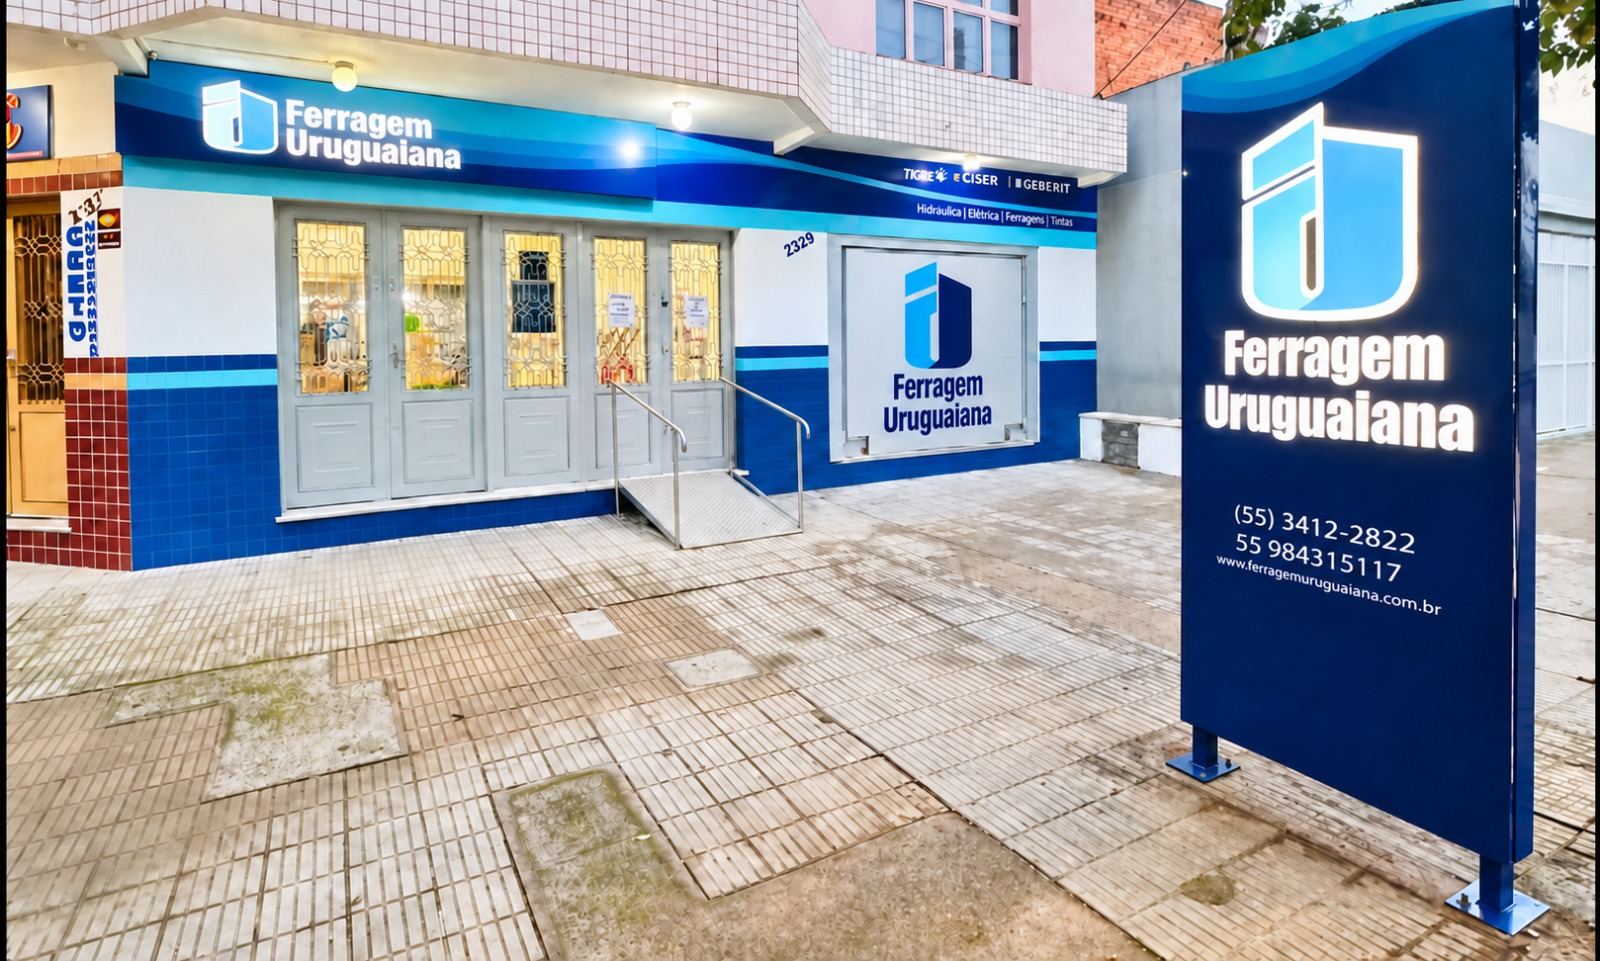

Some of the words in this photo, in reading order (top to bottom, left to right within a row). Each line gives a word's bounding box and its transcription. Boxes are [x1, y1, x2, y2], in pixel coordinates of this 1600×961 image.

[286, 98, 432, 140] Ferragem
[286, 128, 462, 170] Uruguaiana
[904, 168, 934, 182] TIGRE
[962, 172, 998, 186] CISER
[1023, 178, 1070, 194] GEBERIT
[917, 203, 962, 218] Hidráulica
[968, 207, 999, 221] Elétrica
[1005, 211, 1045, 226] Ferragens
[1051, 216, 1073, 227] Tintas
[783, 231, 815, 257] 2329
[1224, 329, 1445, 386] Ferragem
[893, 373, 983, 402] Ferragem
[883, 402, 992, 436] Uruguaiana
[1204, 384, 1474, 452] Uruguaiana
[1234, 504, 1275, 531] (55)
[1282, 511, 1416, 555] 3412-2822
[1235, 532, 1262, 555] 55
[1268, 539, 1402, 582] 984315117
[1216, 554, 1442, 616] www.ferragemuruguaiana.com.br
